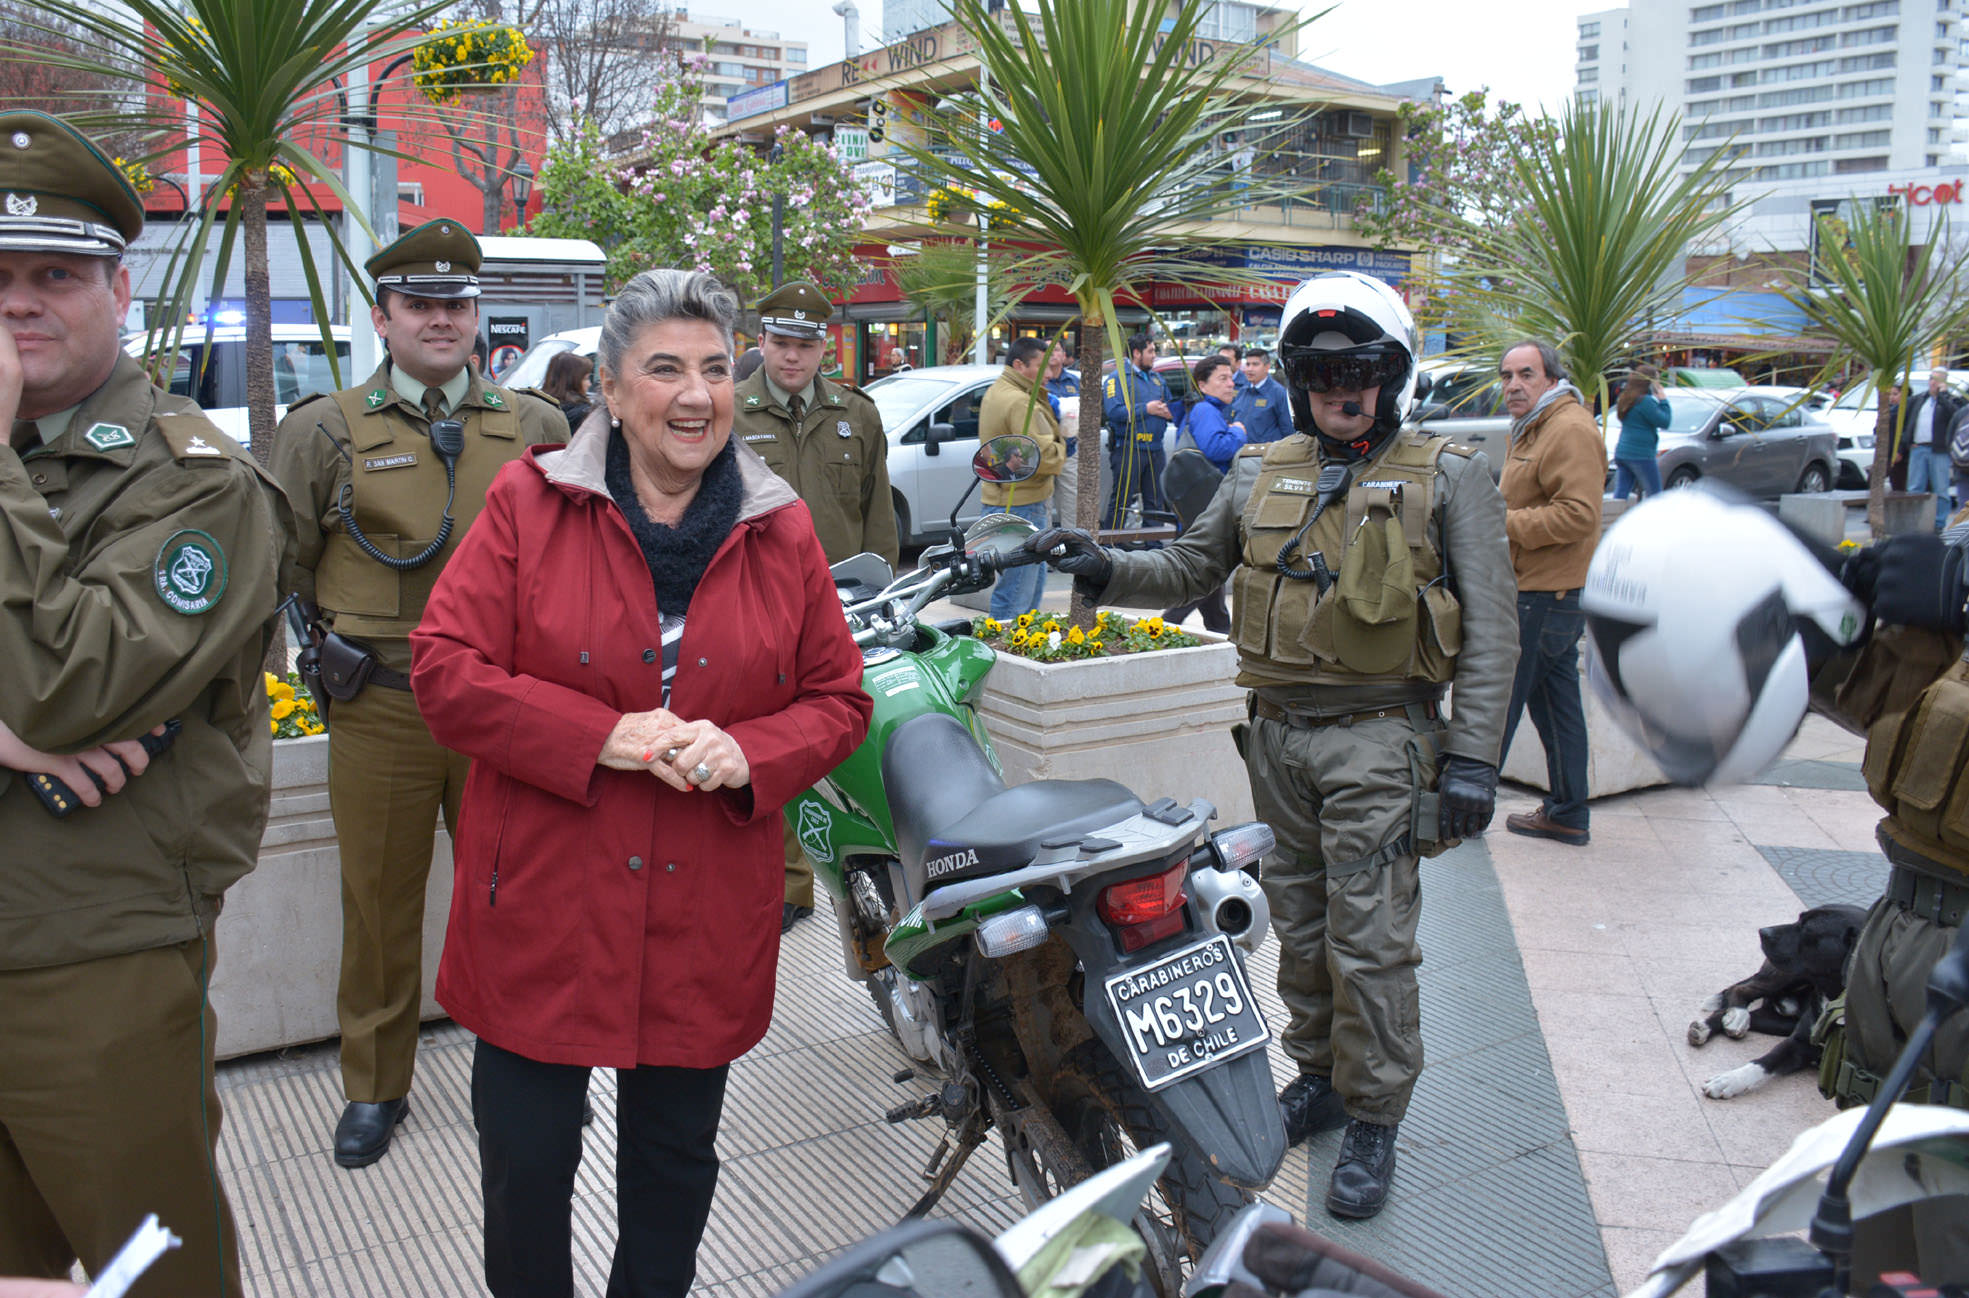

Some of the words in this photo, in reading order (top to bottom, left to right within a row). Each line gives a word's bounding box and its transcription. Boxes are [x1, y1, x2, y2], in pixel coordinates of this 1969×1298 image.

[841, 57, 860, 86] RE
[887, 37, 937, 72] WIND
[1249, 246, 1298, 262] CASIO
[1298, 250, 1355, 265] SHARP
[386, 456, 407, 466] MARTIN
[926, 848, 980, 879] HONDA
[1118, 947, 1225, 1001] CARABINEROS
[1125, 972, 1244, 1054] M6329
[1167, 1046, 1191, 1069] DE
[1193, 1027, 1239, 1058] CHILE
